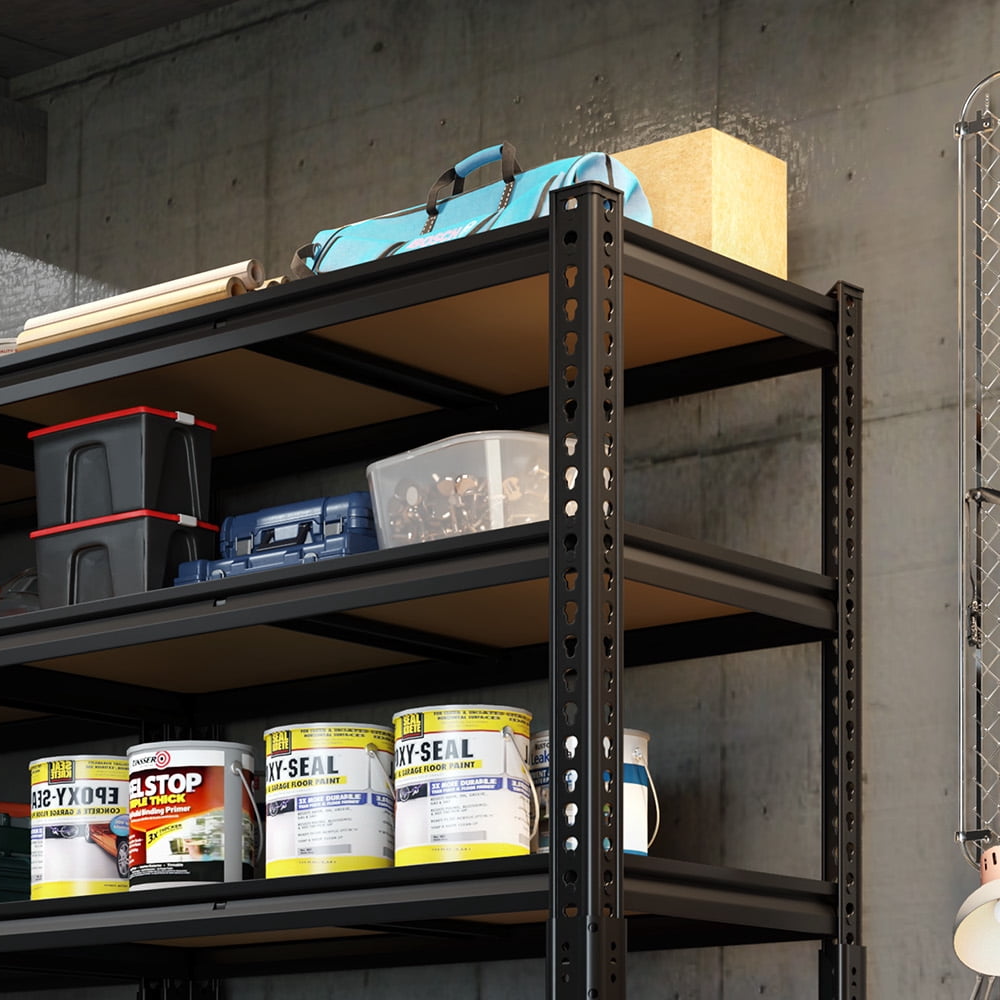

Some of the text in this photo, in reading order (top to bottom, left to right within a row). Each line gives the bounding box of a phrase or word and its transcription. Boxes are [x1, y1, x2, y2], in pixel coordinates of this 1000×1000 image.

[531, 750, 550, 765] Leak
[423, 762, 446, 772] FLOOR
[449, 761, 476, 769] PAINT
[144, 773, 202, 796] STOP
[291, 779, 314, 788] FLOOR
[315, 777, 341, 785] PAINT
[149, 794, 186, 805] THICK
[165, 805, 191, 814] Primer
